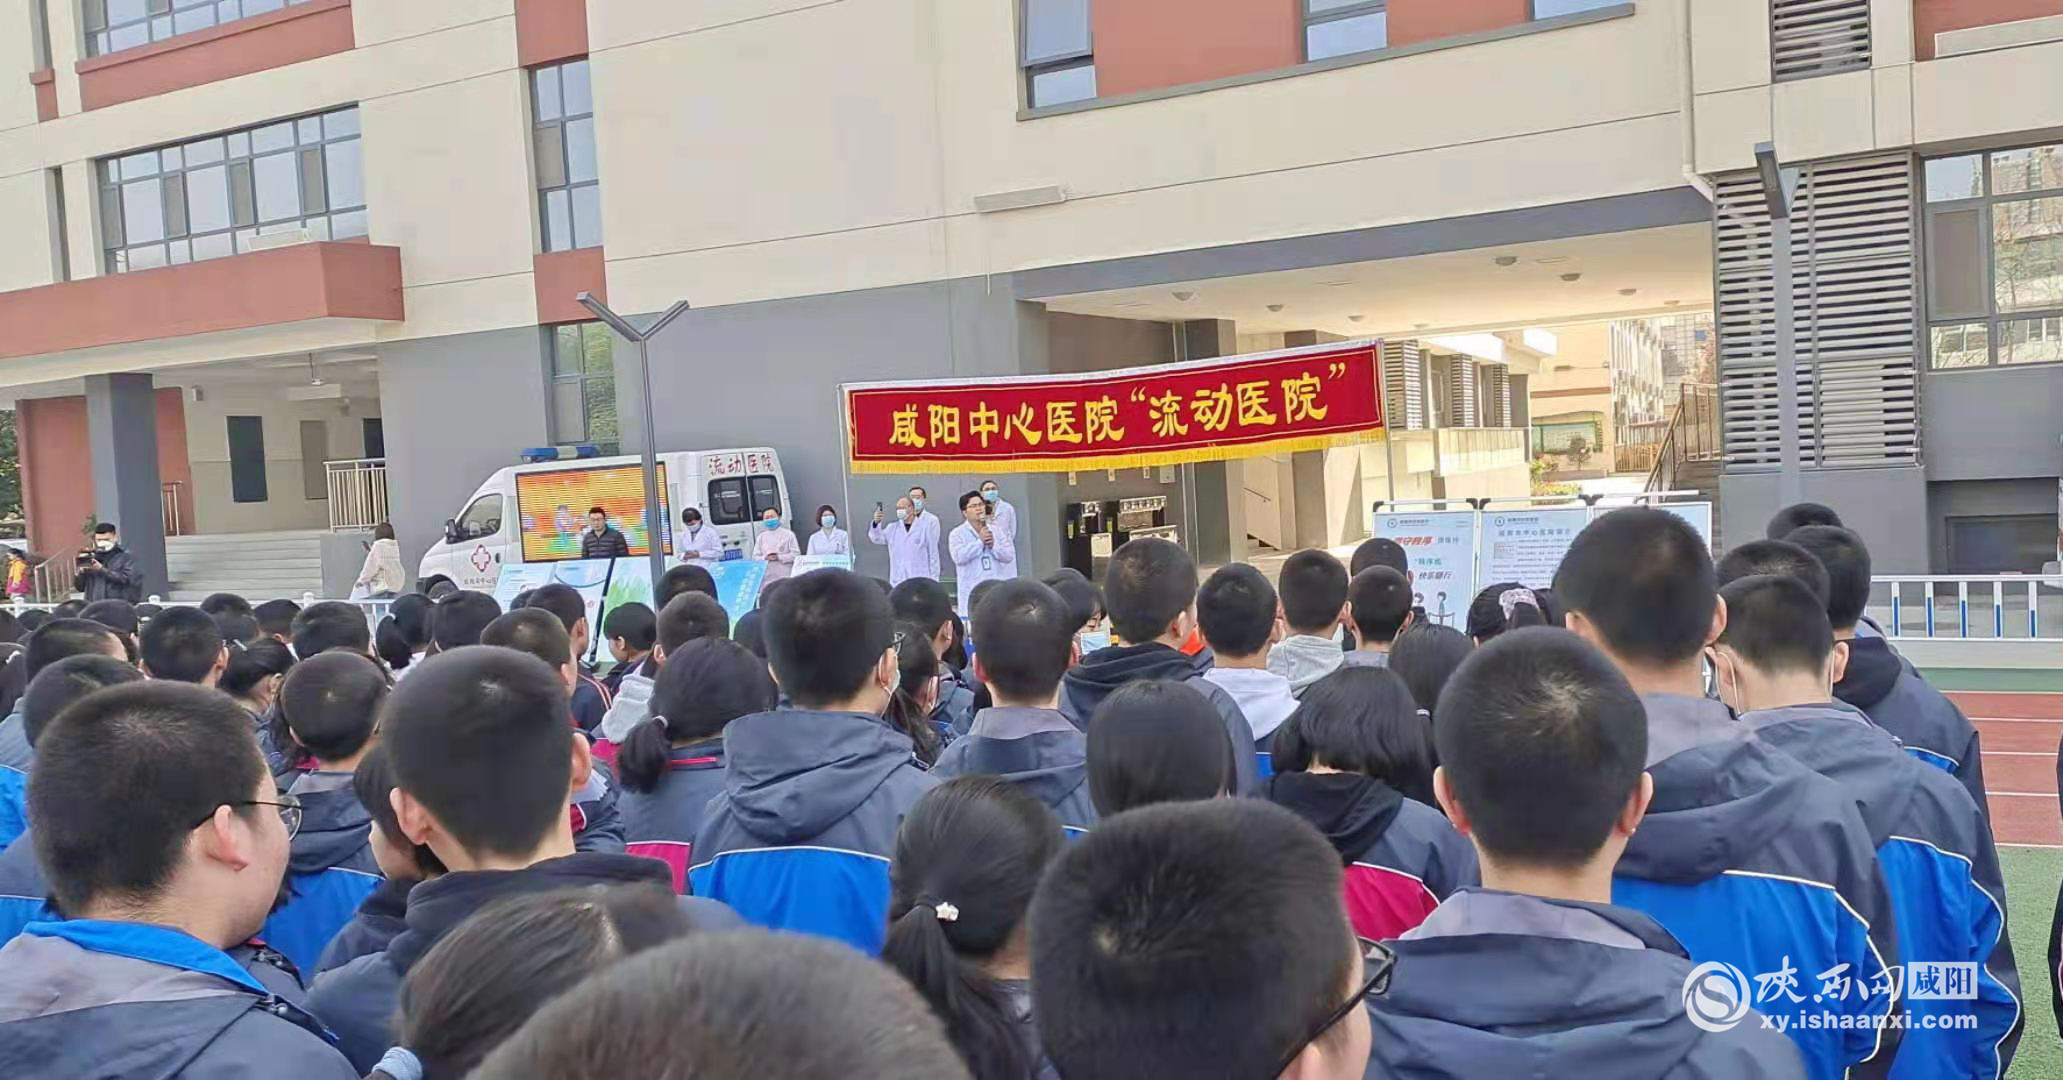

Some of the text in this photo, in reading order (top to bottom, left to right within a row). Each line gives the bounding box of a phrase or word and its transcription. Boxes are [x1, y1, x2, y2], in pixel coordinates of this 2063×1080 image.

[888, 362, 1347, 449] 咸阳中心医院“流动医院”
[709, 452, 774, 476] 流动医院
